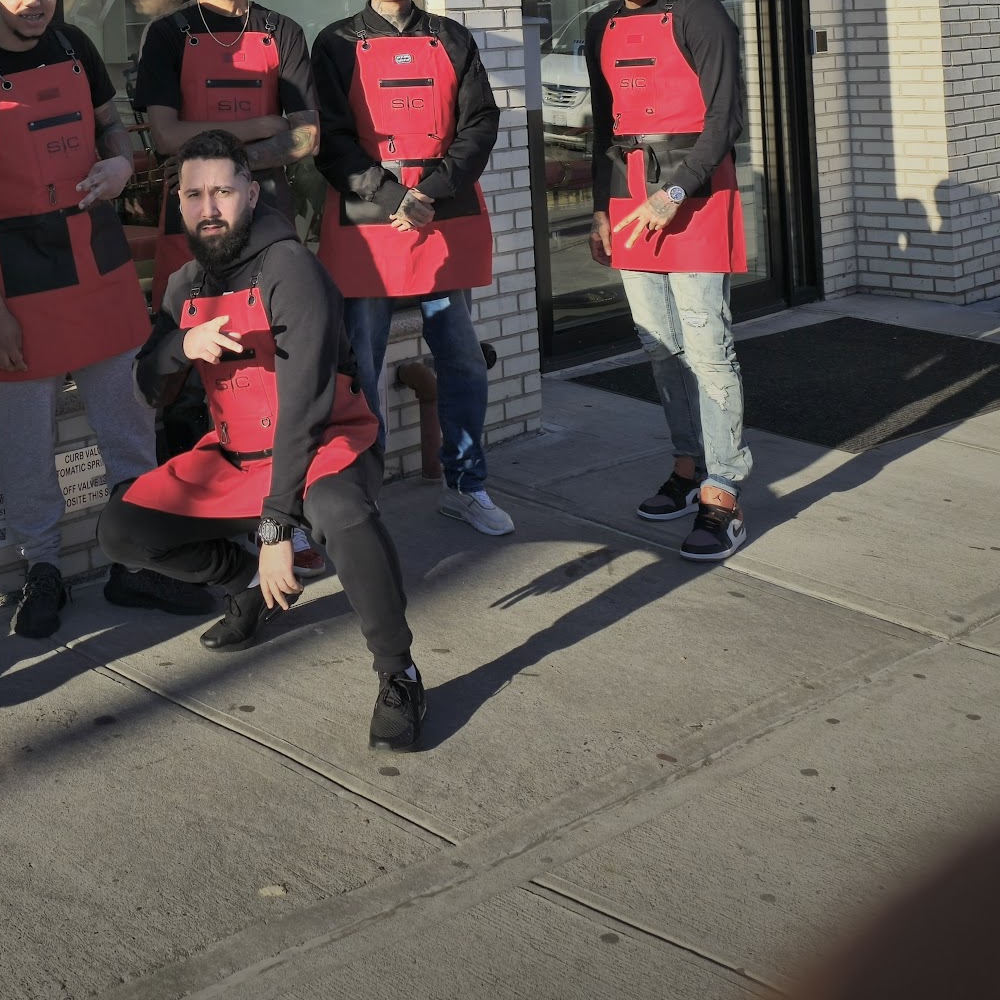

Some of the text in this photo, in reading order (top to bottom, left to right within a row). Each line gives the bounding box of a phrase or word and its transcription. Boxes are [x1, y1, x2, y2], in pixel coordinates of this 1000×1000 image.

[64, 451, 84, 464] CURB
[63, 484, 76, 496] OFF
[77, 478, 99, 491] VALVE
[88, 490, 104, 501] THIS
